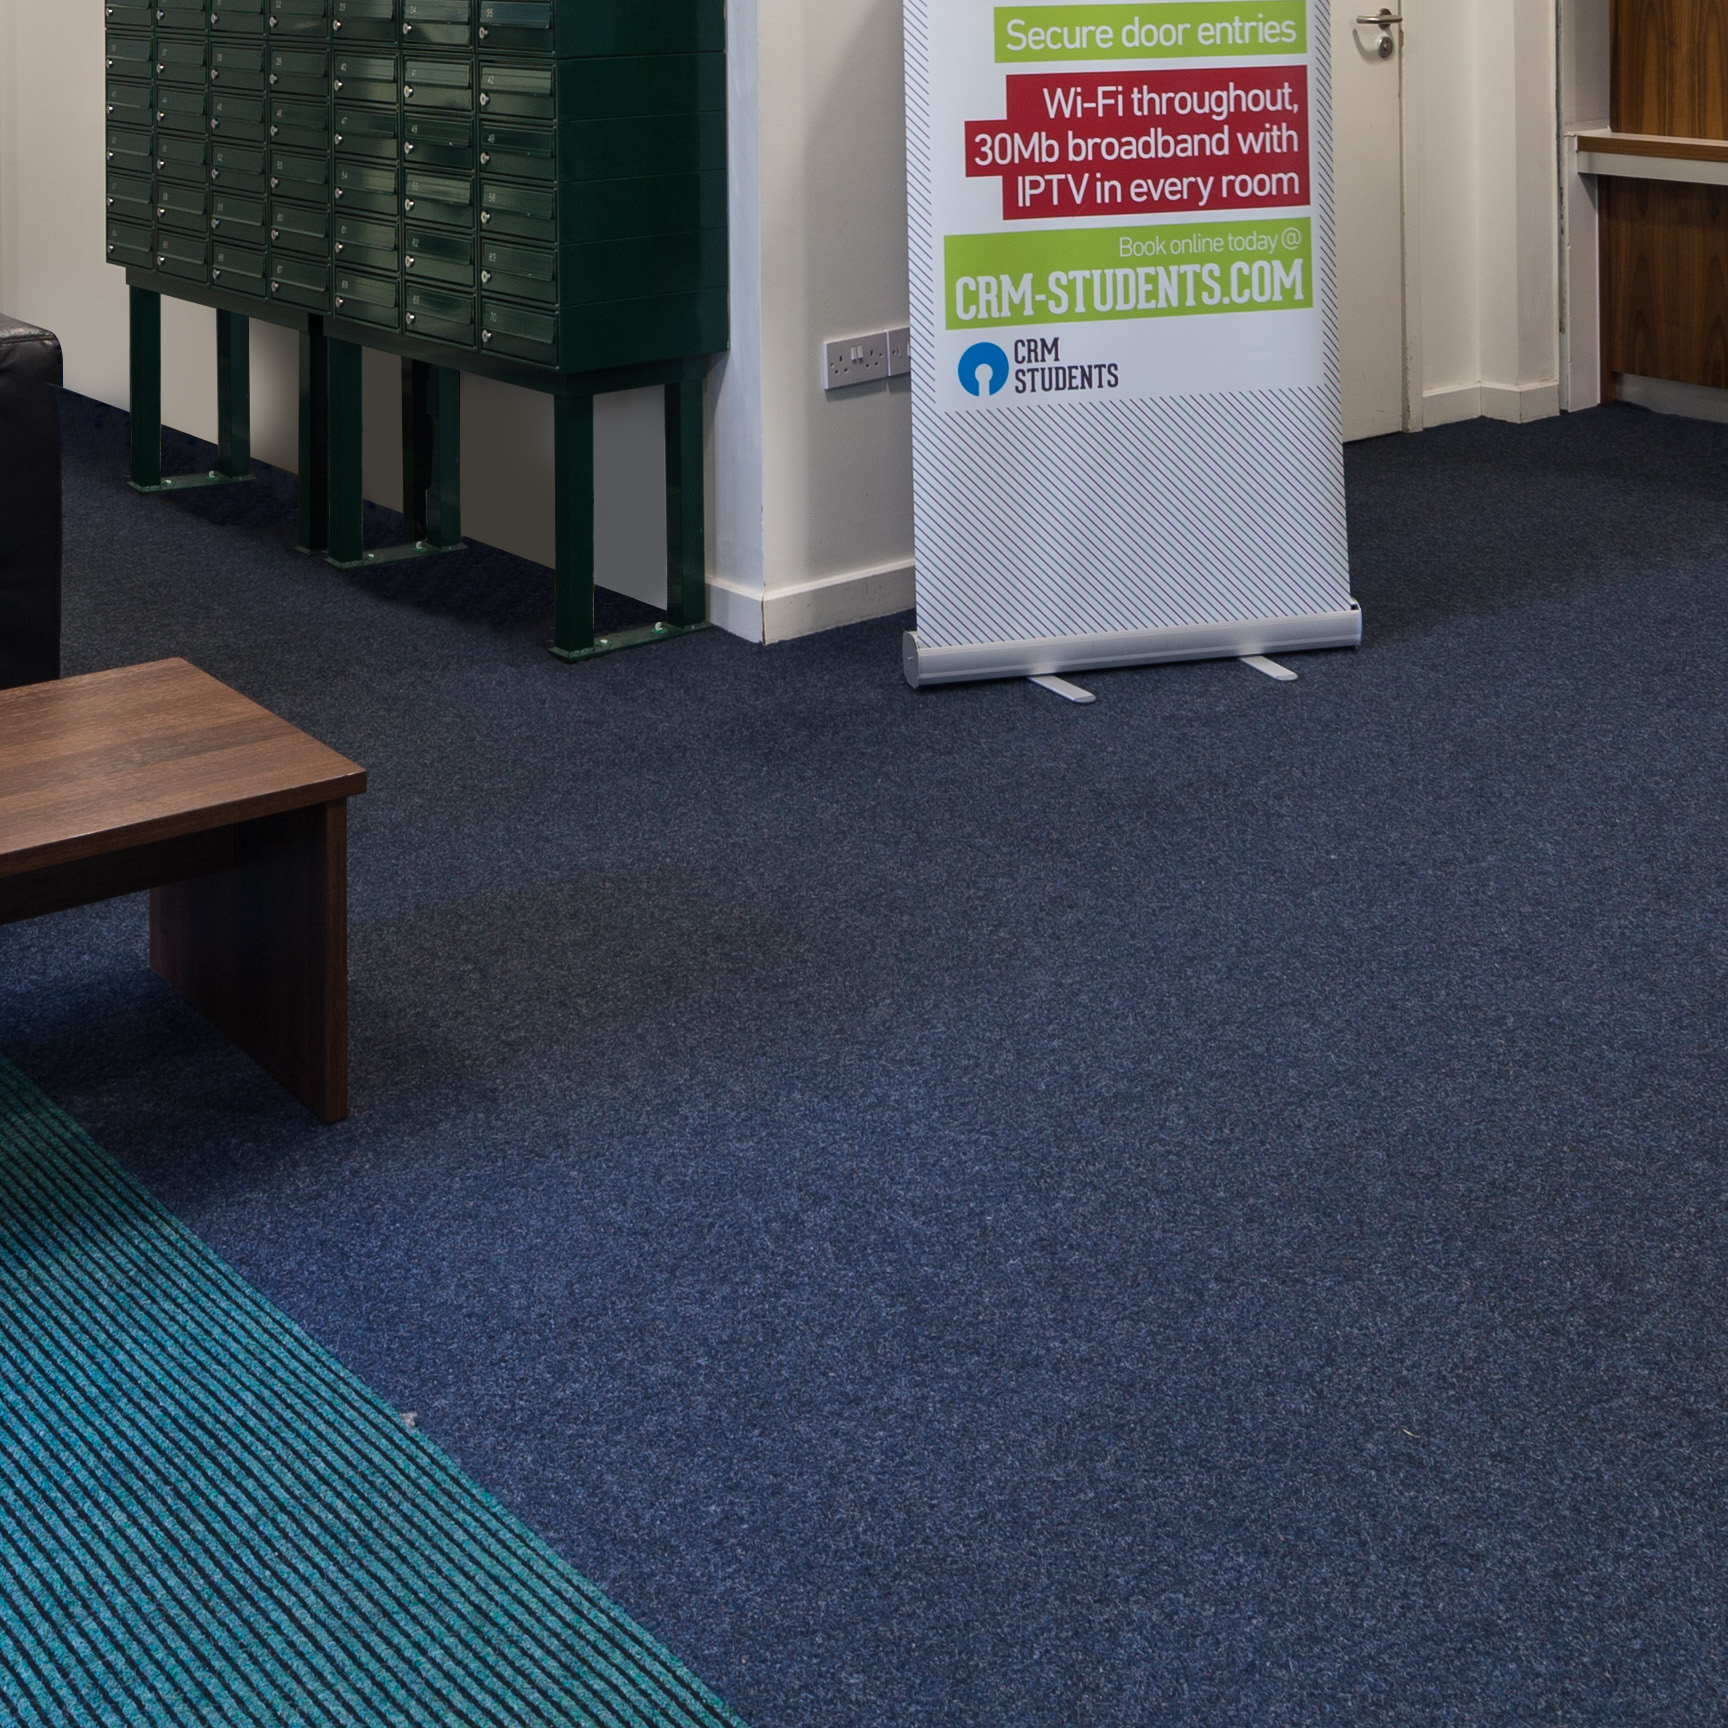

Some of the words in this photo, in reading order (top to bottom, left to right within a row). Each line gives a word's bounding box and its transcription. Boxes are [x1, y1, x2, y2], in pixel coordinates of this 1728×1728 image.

[1006, 18, 1114, 51] Secure
[1121, 16, 1190, 47] door
[1197, 13, 1297, 46] entries
[1042, 86, 1123, 119] Wi-Fi
[1131, 81, 1299, 120] throughout,
[974, 132, 1059, 166] 30Mb
[1067, 127, 1230, 161] broadband
[1236, 123, 1299, 155] with
[1017, 174, 1088, 207] IPTV
[1096, 172, 1121, 203] in
[1130, 175, 1214, 206] every
[1221, 171, 1300, 197] room
[1119, 235, 1166, 258] Book
[1170, 232, 1225, 256] online
[1227, 231, 1278, 256] today
[1280, 228, 1302, 250] @
[955, 258, 1304, 320] CRM-STUDENTS.COM
[1014, 337, 1060, 364] CRM
[1014, 362, 1119, 394] STUDENTS
